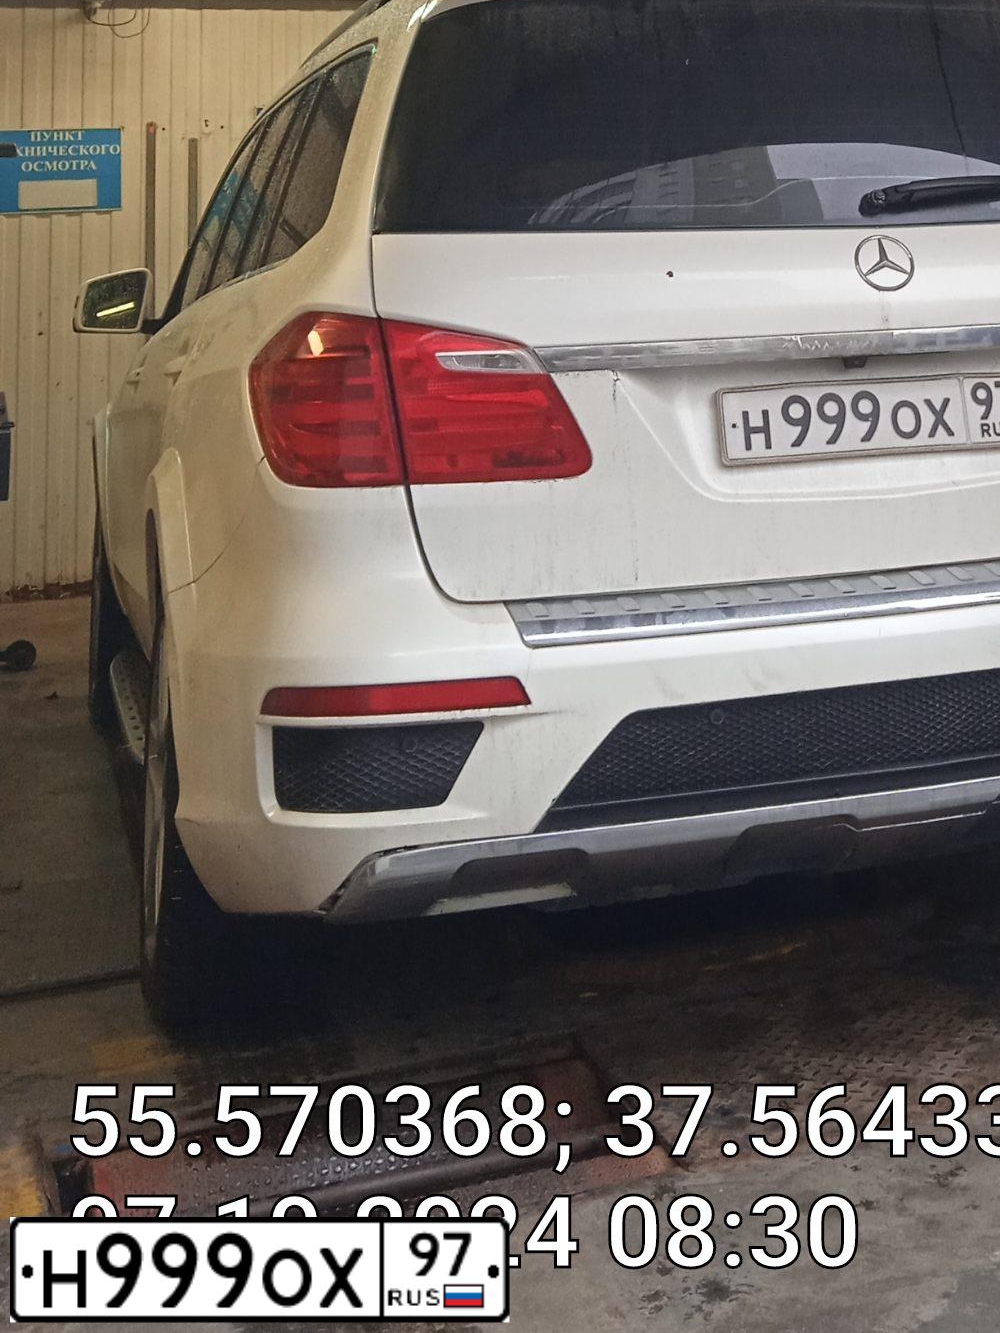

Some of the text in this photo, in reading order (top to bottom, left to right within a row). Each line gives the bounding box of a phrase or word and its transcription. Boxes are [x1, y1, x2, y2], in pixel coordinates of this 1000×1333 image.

[30, 130, 85, 142] ПУНКТ
[15, 144, 121, 157] ХНИЧЕСКОГО
[21, 159, 97, 172] ОСМОТРА
